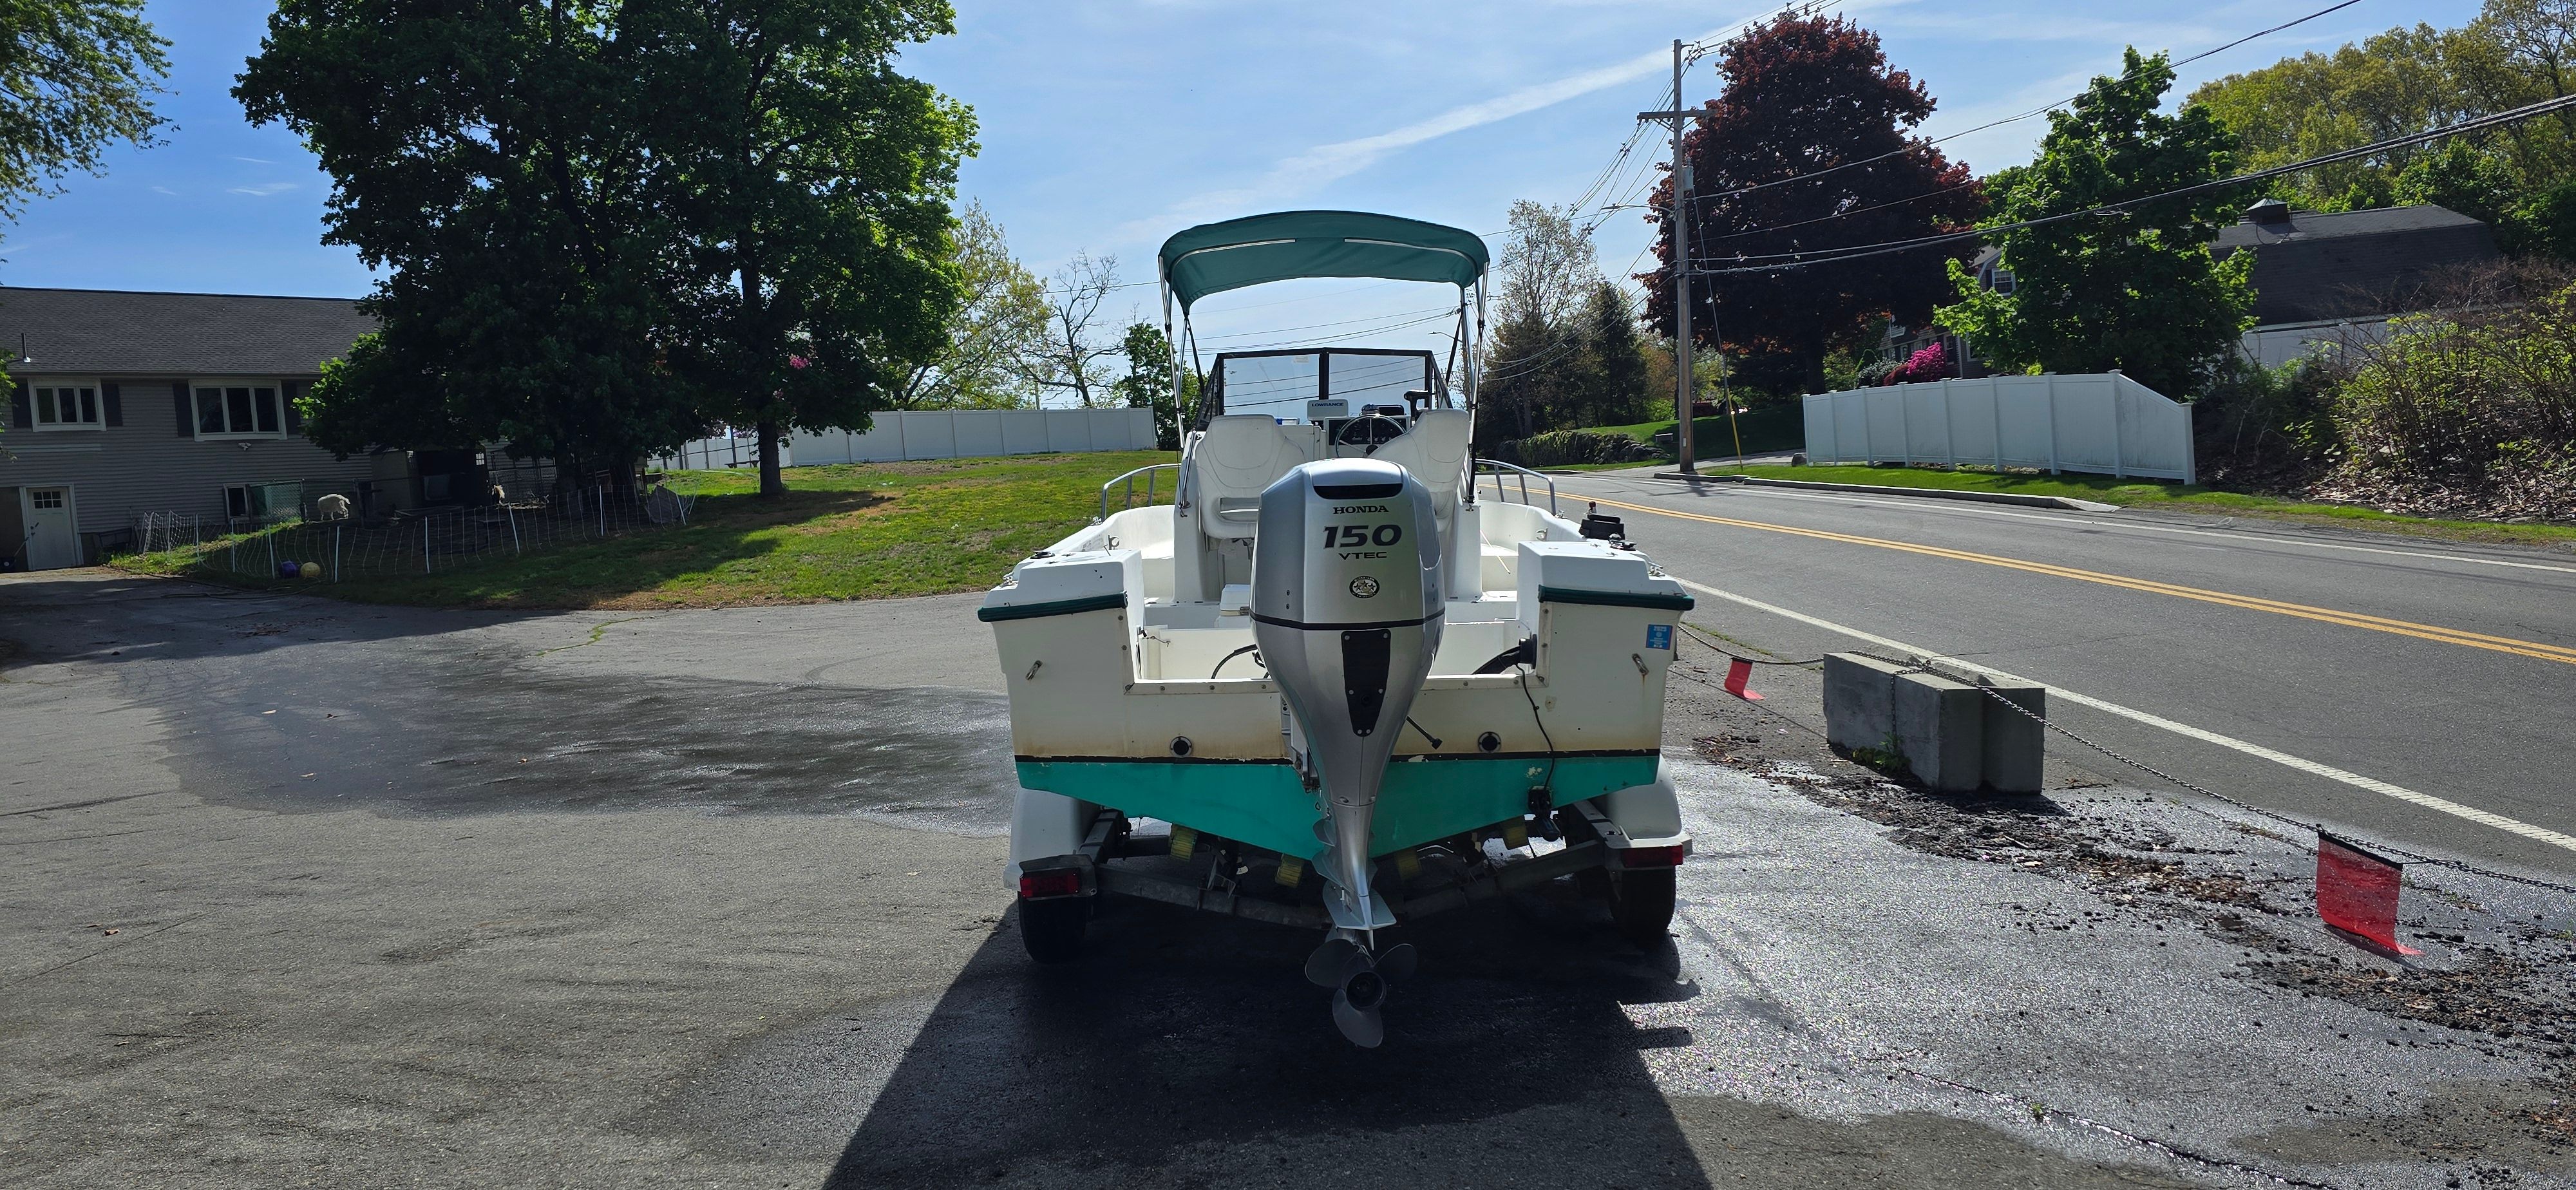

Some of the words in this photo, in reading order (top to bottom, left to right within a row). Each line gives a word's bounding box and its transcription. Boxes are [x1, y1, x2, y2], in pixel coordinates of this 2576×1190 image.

[1333, 505, 1390, 515] HONDA
[1323, 524, 1402, 549] 150
[1338, 551, 1387, 561] VTEC
